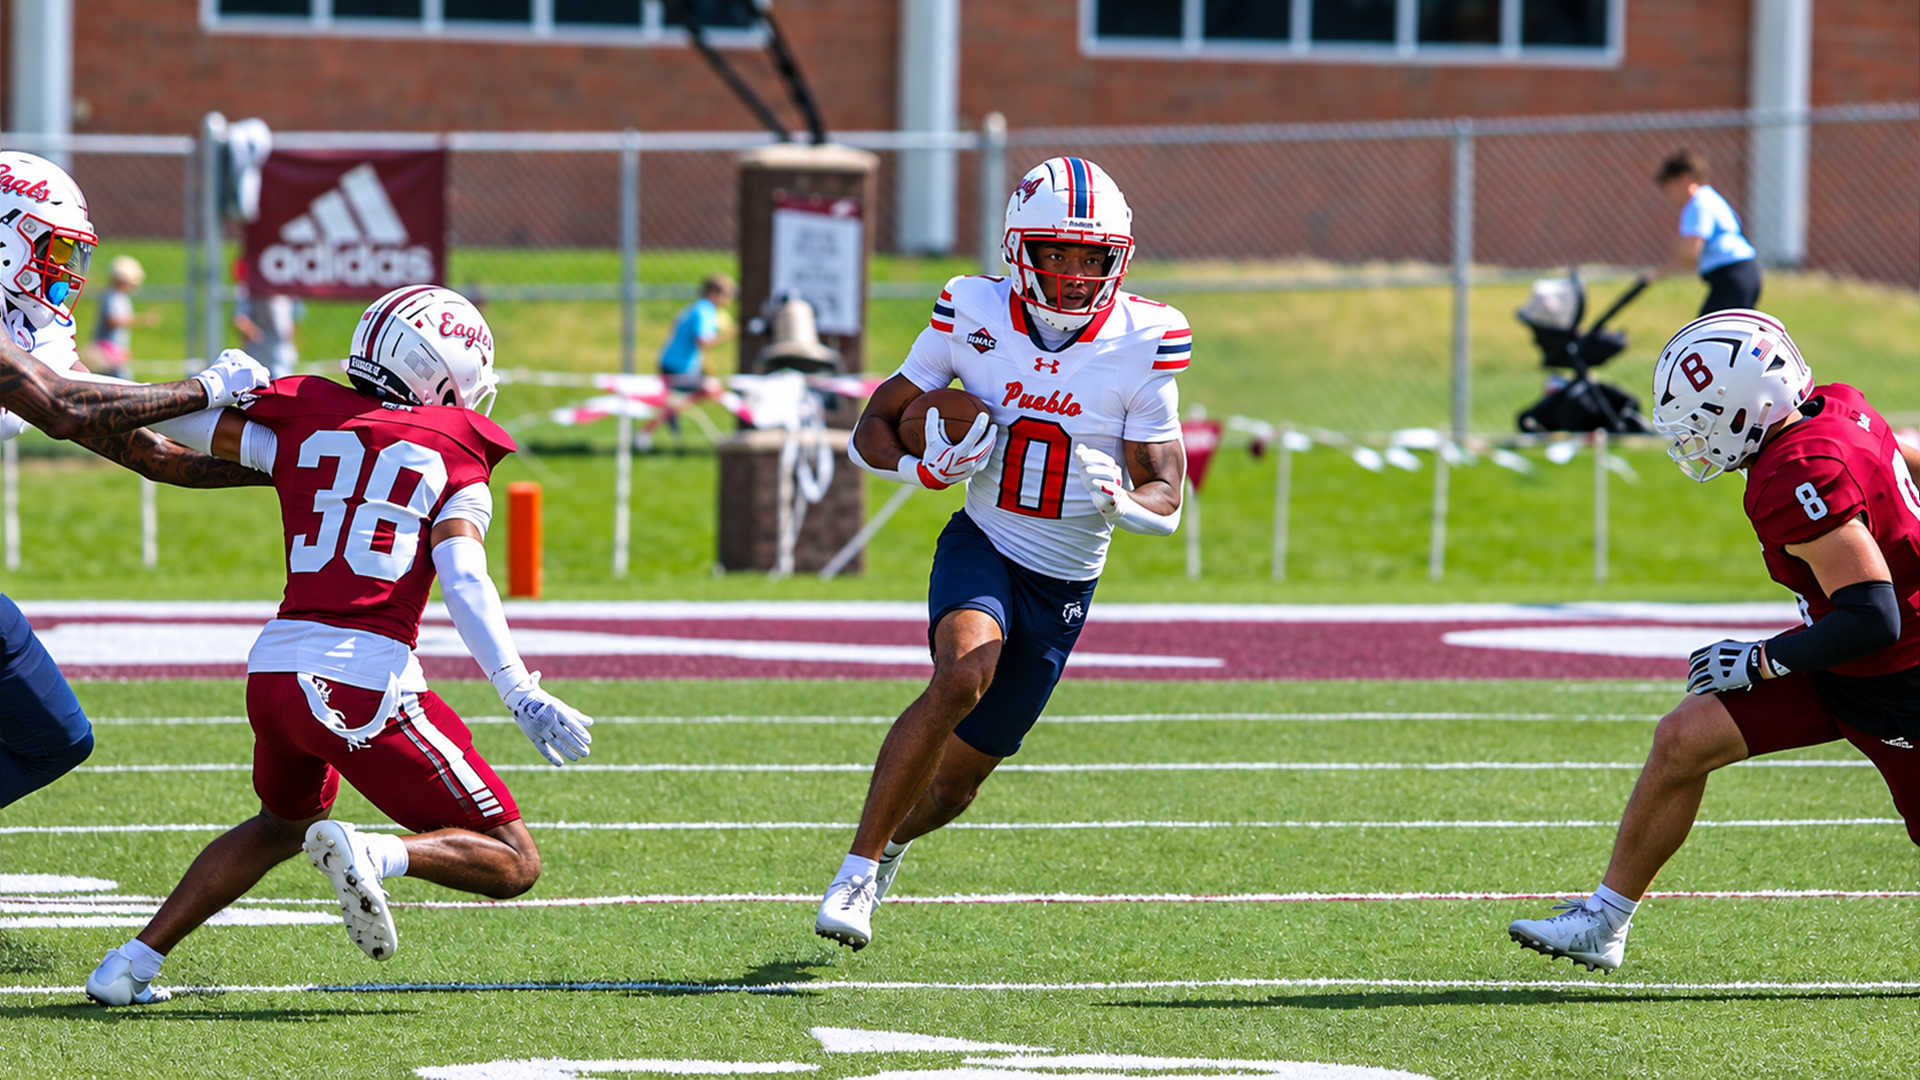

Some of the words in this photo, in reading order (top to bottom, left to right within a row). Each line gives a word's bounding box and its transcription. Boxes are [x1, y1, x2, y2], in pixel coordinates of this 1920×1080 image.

[258, 243, 436, 287] adidas
[439, 311, 492, 351] Eagles
[1680, 352, 1713, 393] B
[1001, 381, 1082, 417] Pueblo
[996, 415, 1072, 520] 0
[289, 429, 449, 583] 38
[1795, 481, 1828, 521] 8
